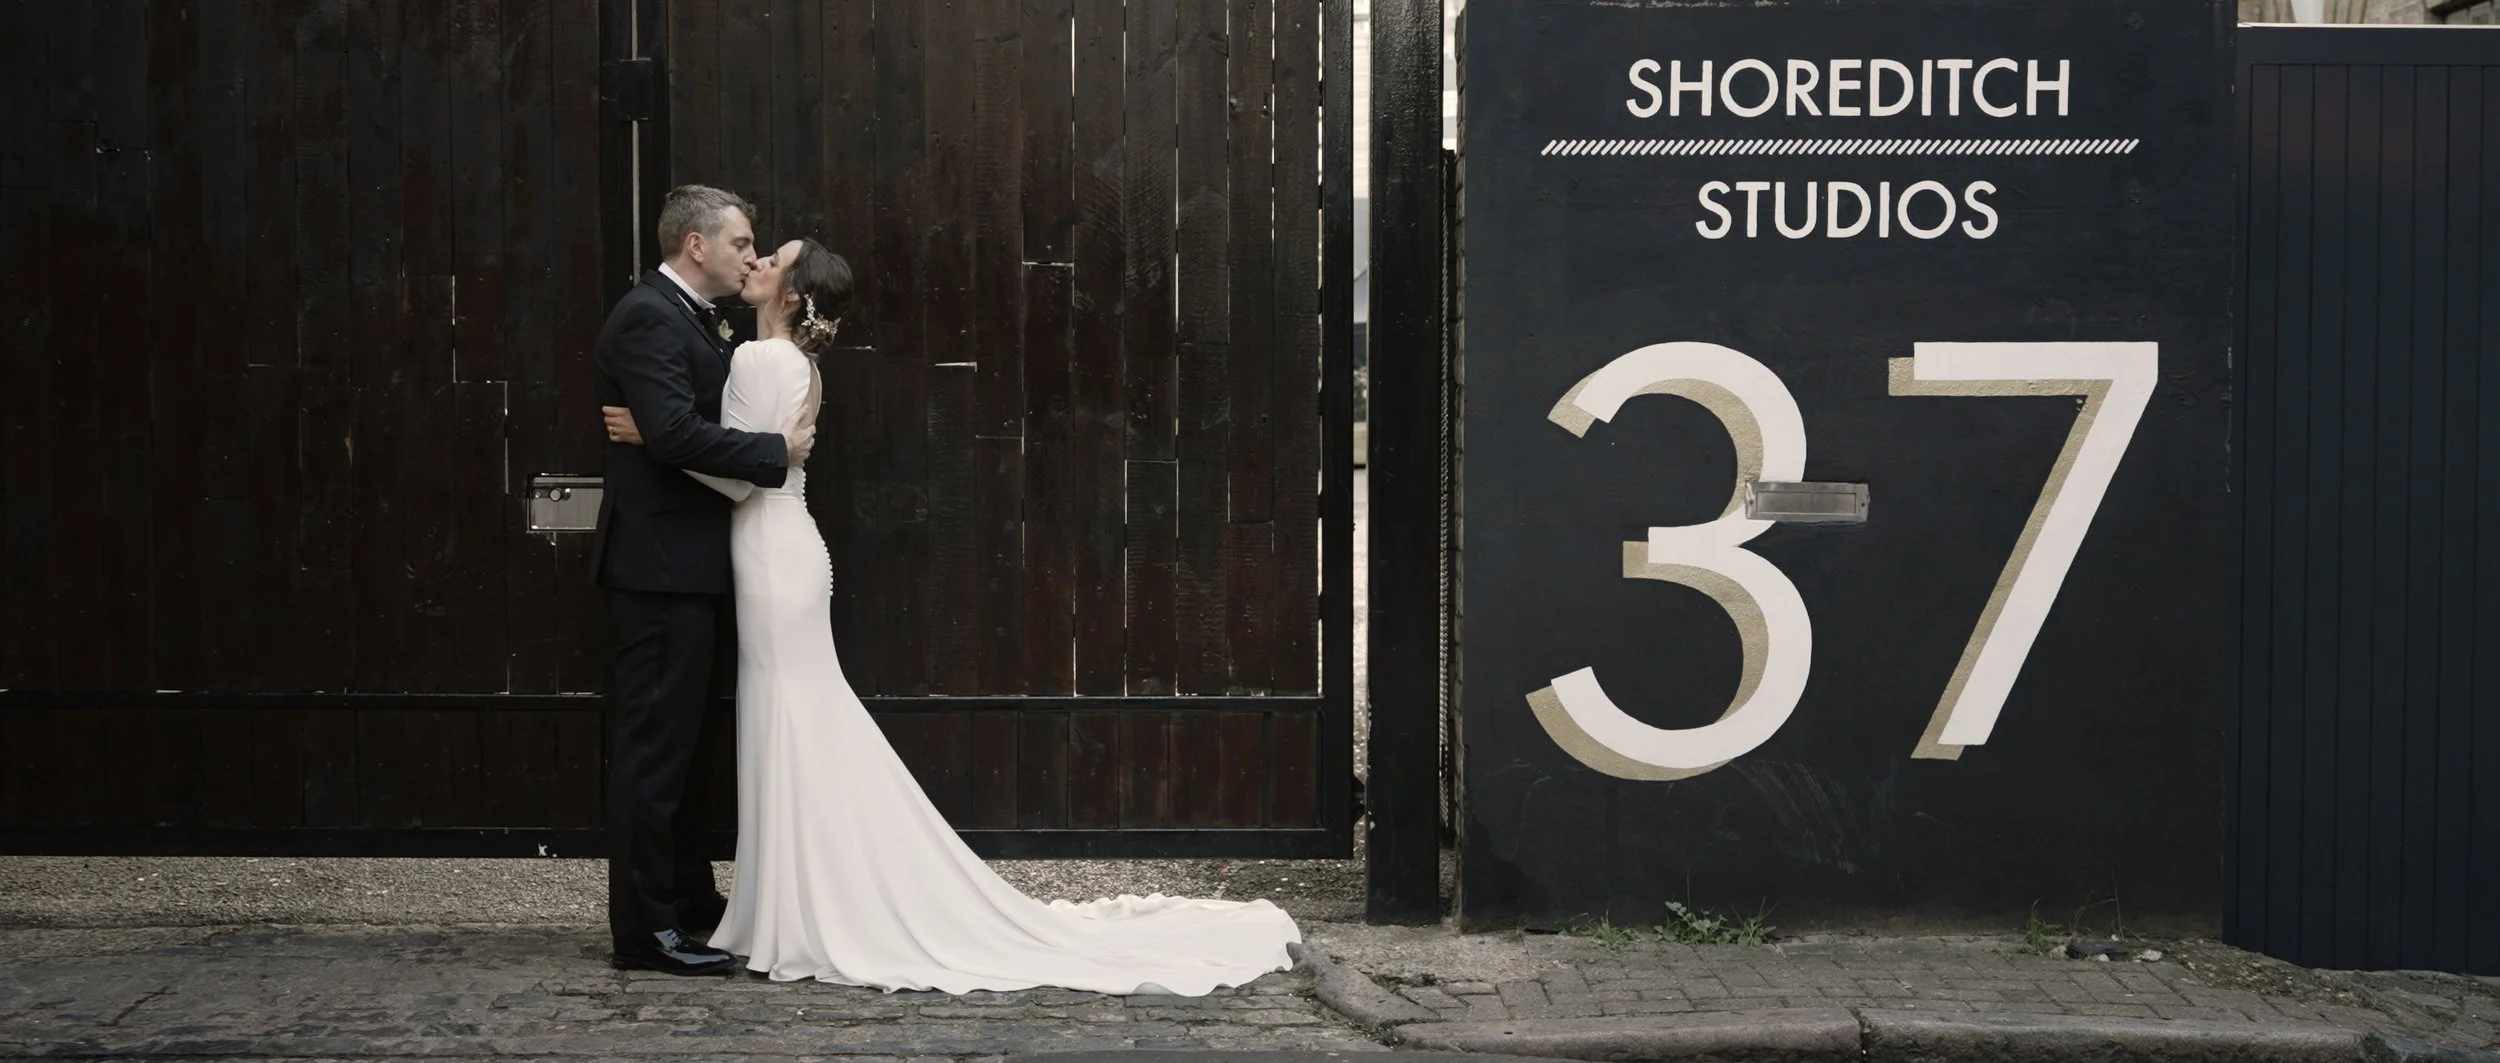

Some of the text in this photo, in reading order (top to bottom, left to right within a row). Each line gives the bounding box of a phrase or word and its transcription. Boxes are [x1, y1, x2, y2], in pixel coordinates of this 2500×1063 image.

[1626, 58, 2070, 118] SHOREDITCH
[1695, 180, 1999, 240] STUDIOS
[1526, 341, 2158, 781] 37
